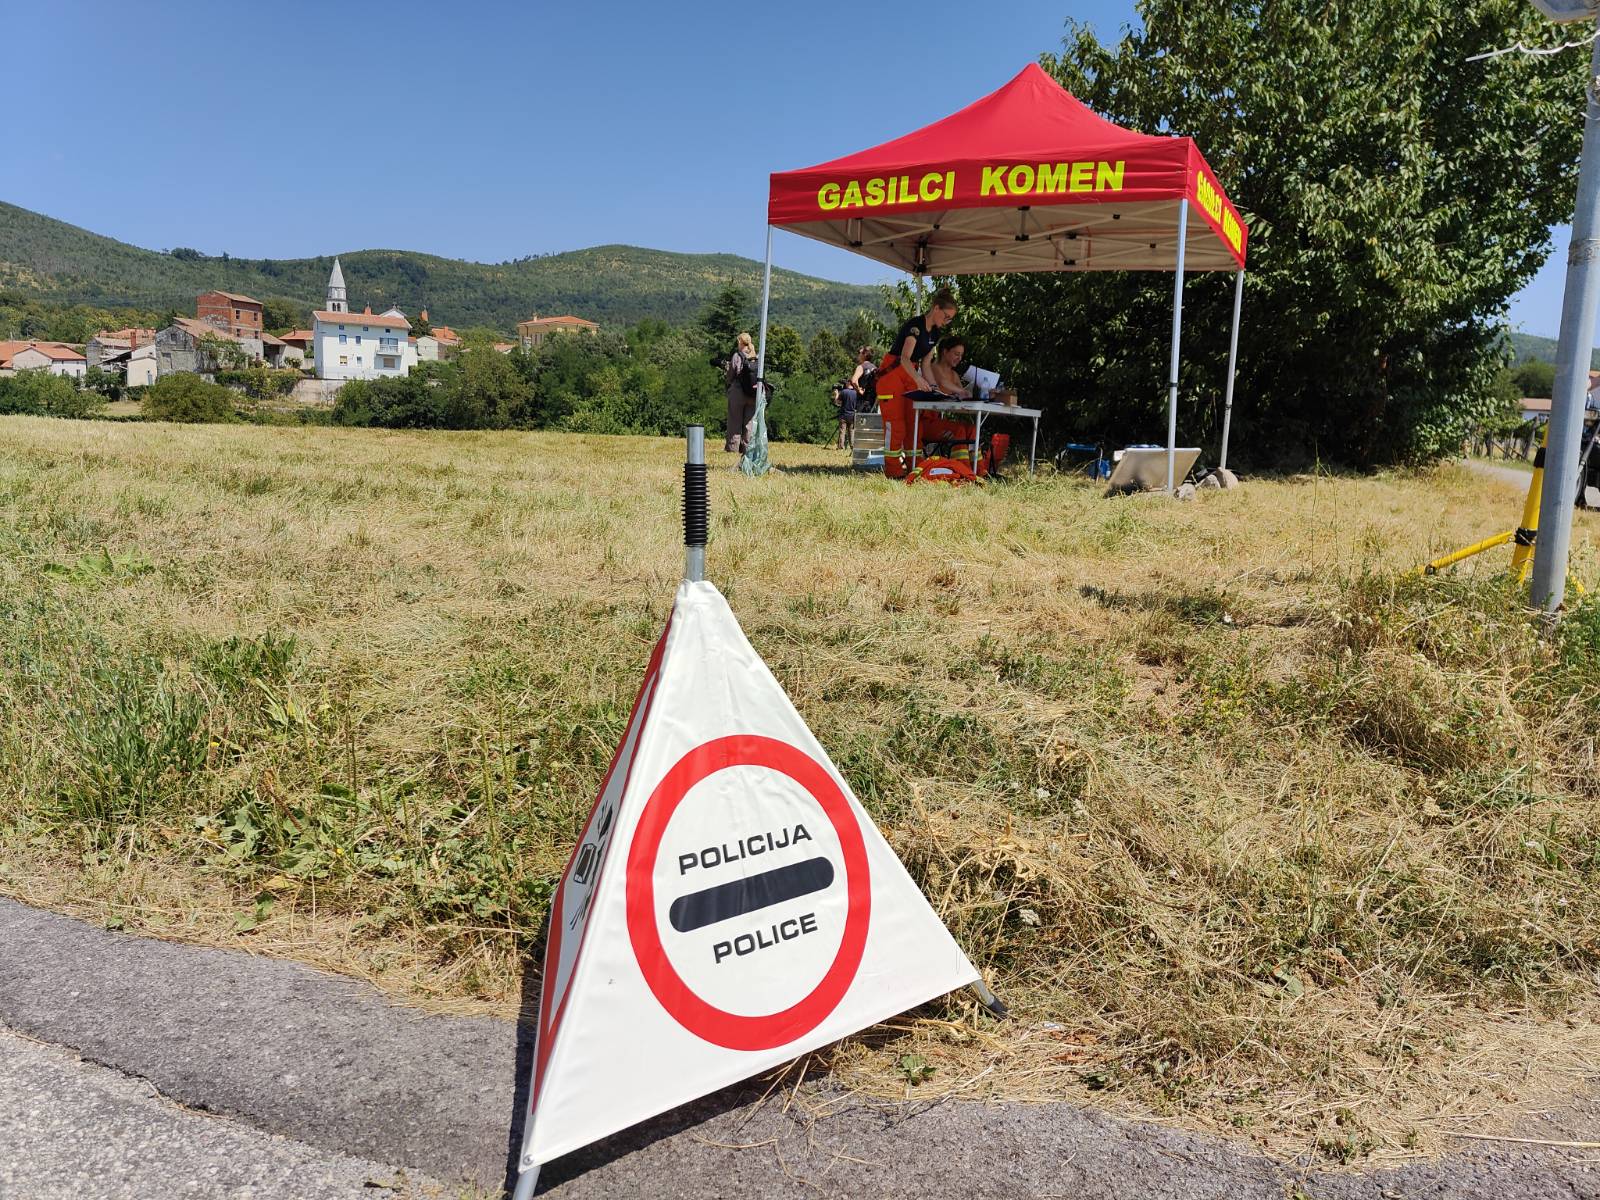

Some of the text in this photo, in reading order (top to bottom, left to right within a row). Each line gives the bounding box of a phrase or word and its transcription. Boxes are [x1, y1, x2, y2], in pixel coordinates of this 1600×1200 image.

[817, 160, 1126, 211] GASILCI KOMEN
[678, 823, 812, 876] POLICIJA
[713, 912, 818, 964] POLICE
